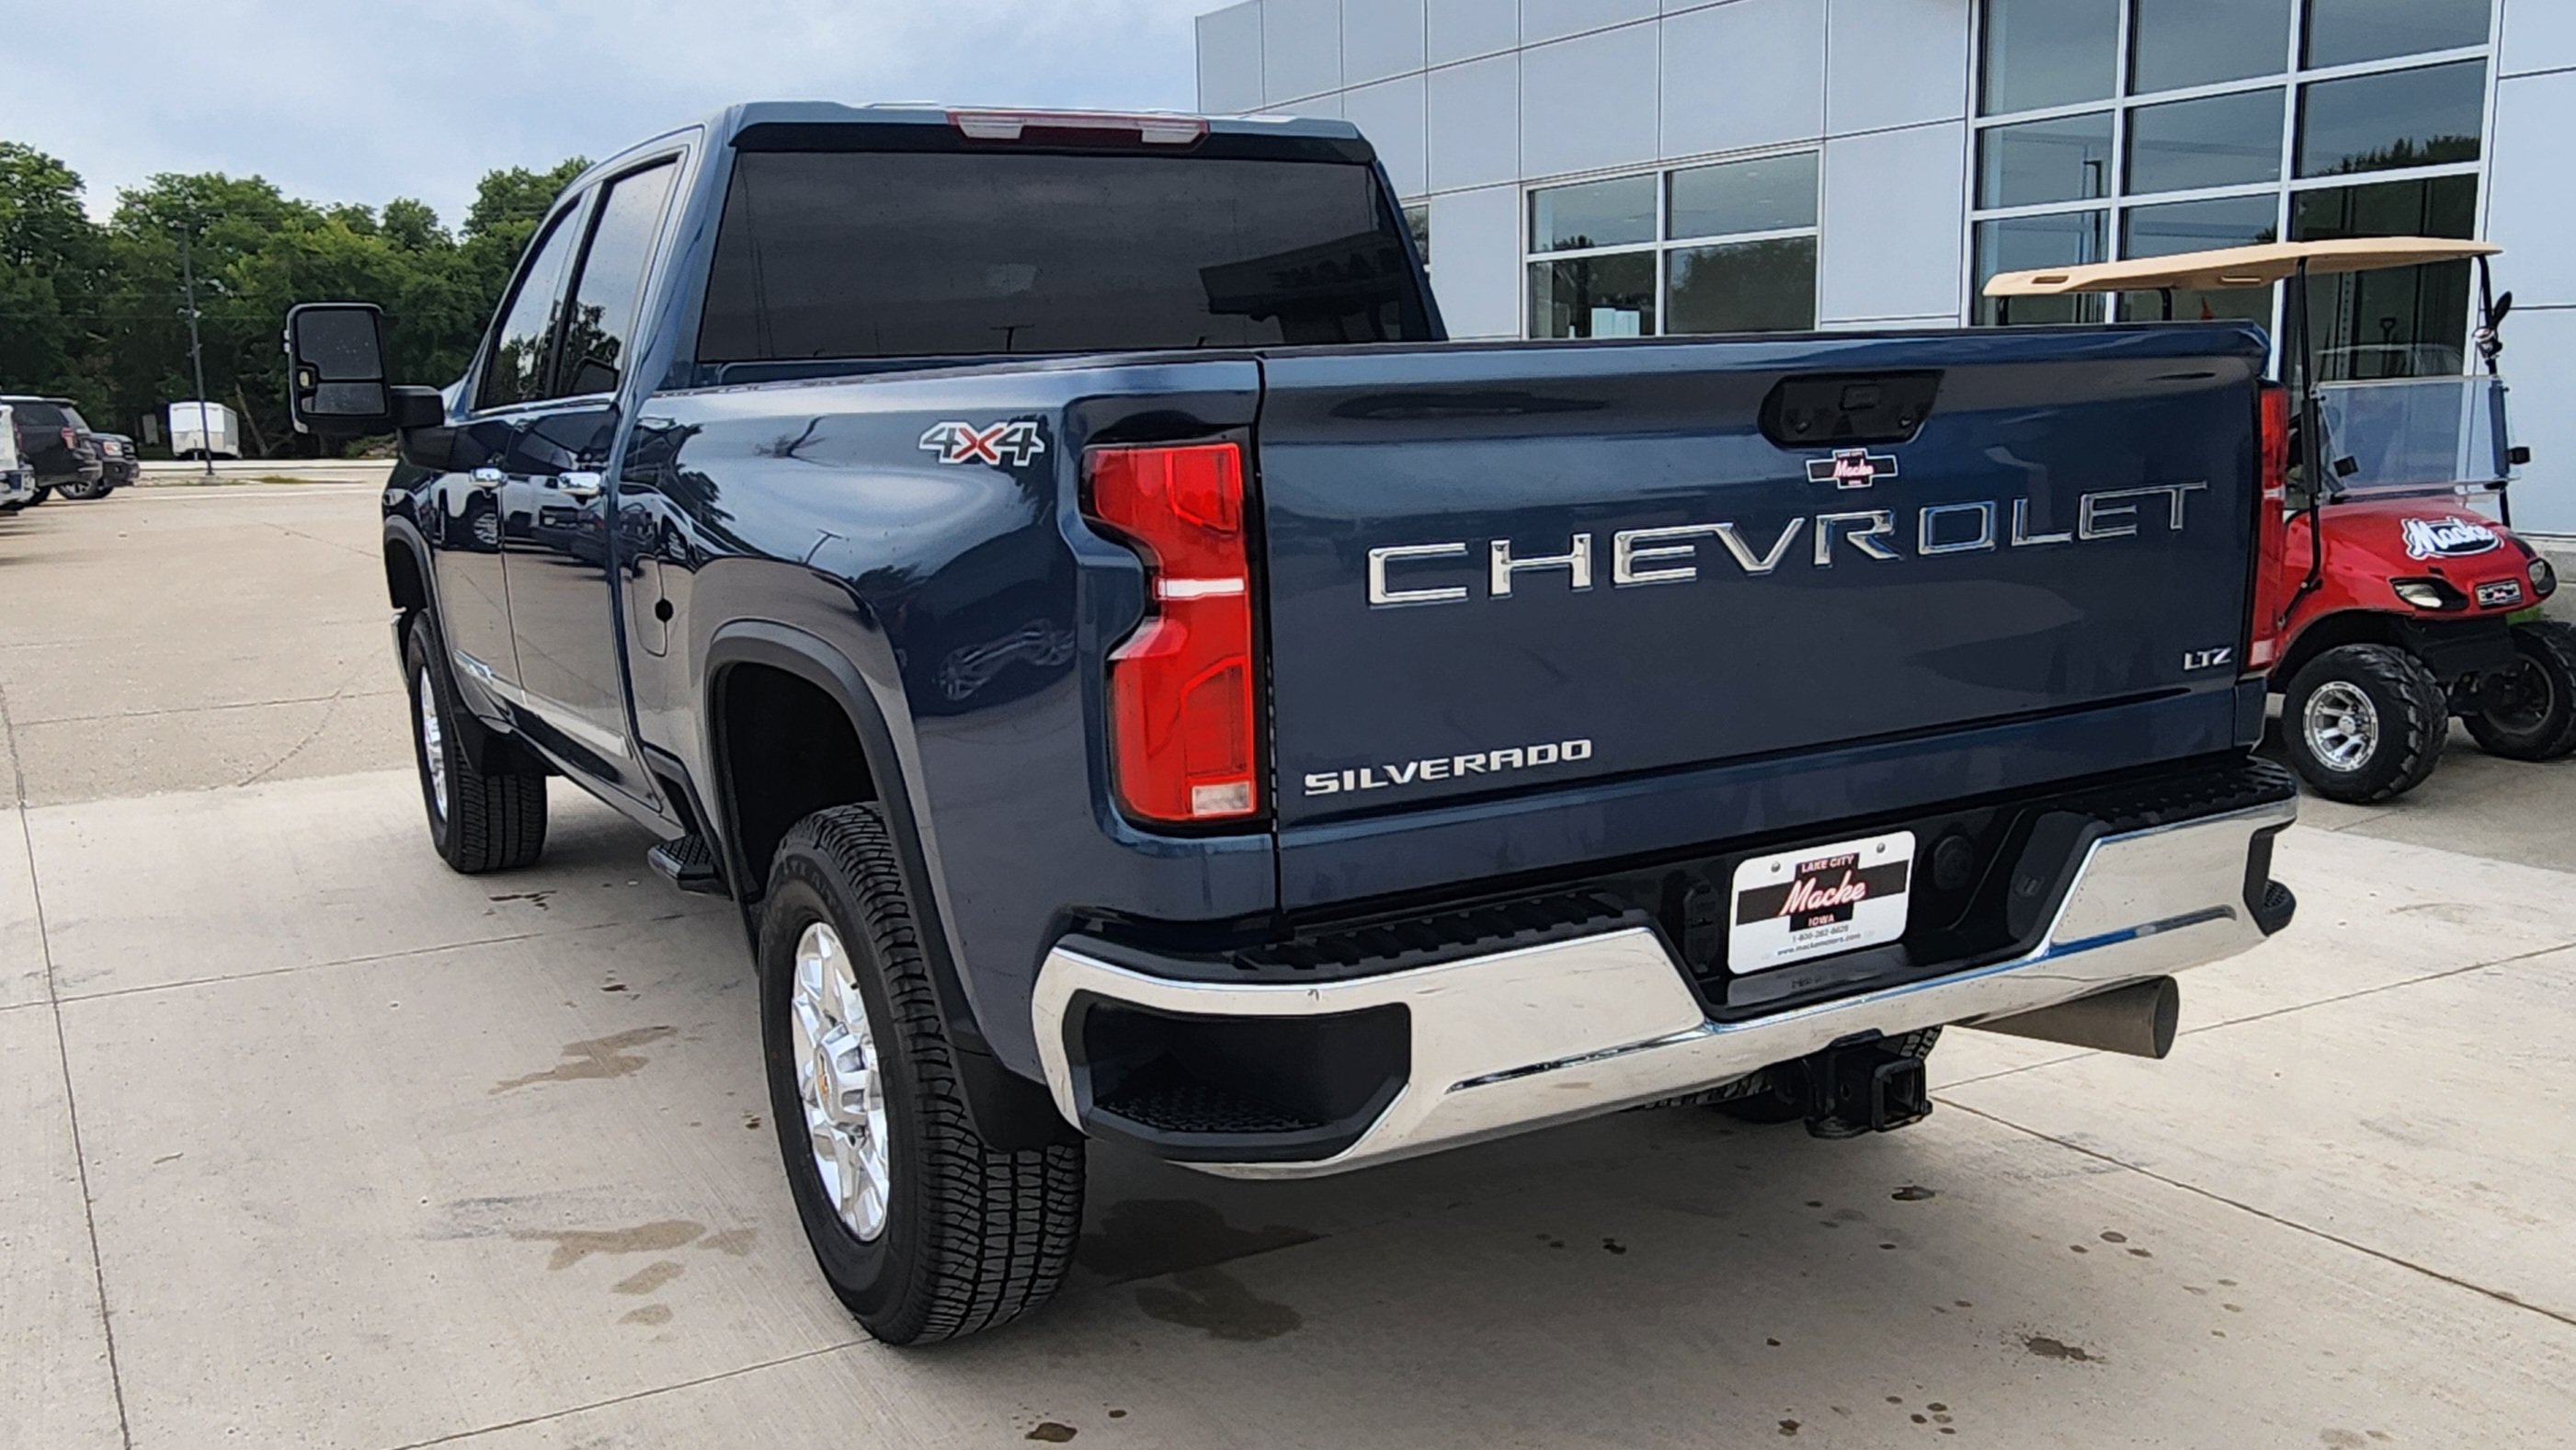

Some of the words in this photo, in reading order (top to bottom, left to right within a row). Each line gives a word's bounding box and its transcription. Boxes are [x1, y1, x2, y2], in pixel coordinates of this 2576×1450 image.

[919, 422, 1044, 466] 4X4
[1832, 458, 1874, 477] Macke
[1368, 480, 2207, 607] CHEVROLET
[2407, 516, 2495, 553] Macke
[2184, 647, 2231, 670] LTZ
[1305, 739, 1591, 796] SILVERADO
[1801, 858, 1829, 873] LAKE
[1829, 853, 1854, 869] CITY
[1778, 870, 1866, 916] Macke
[1807, 913, 1835, 927] IOWA
